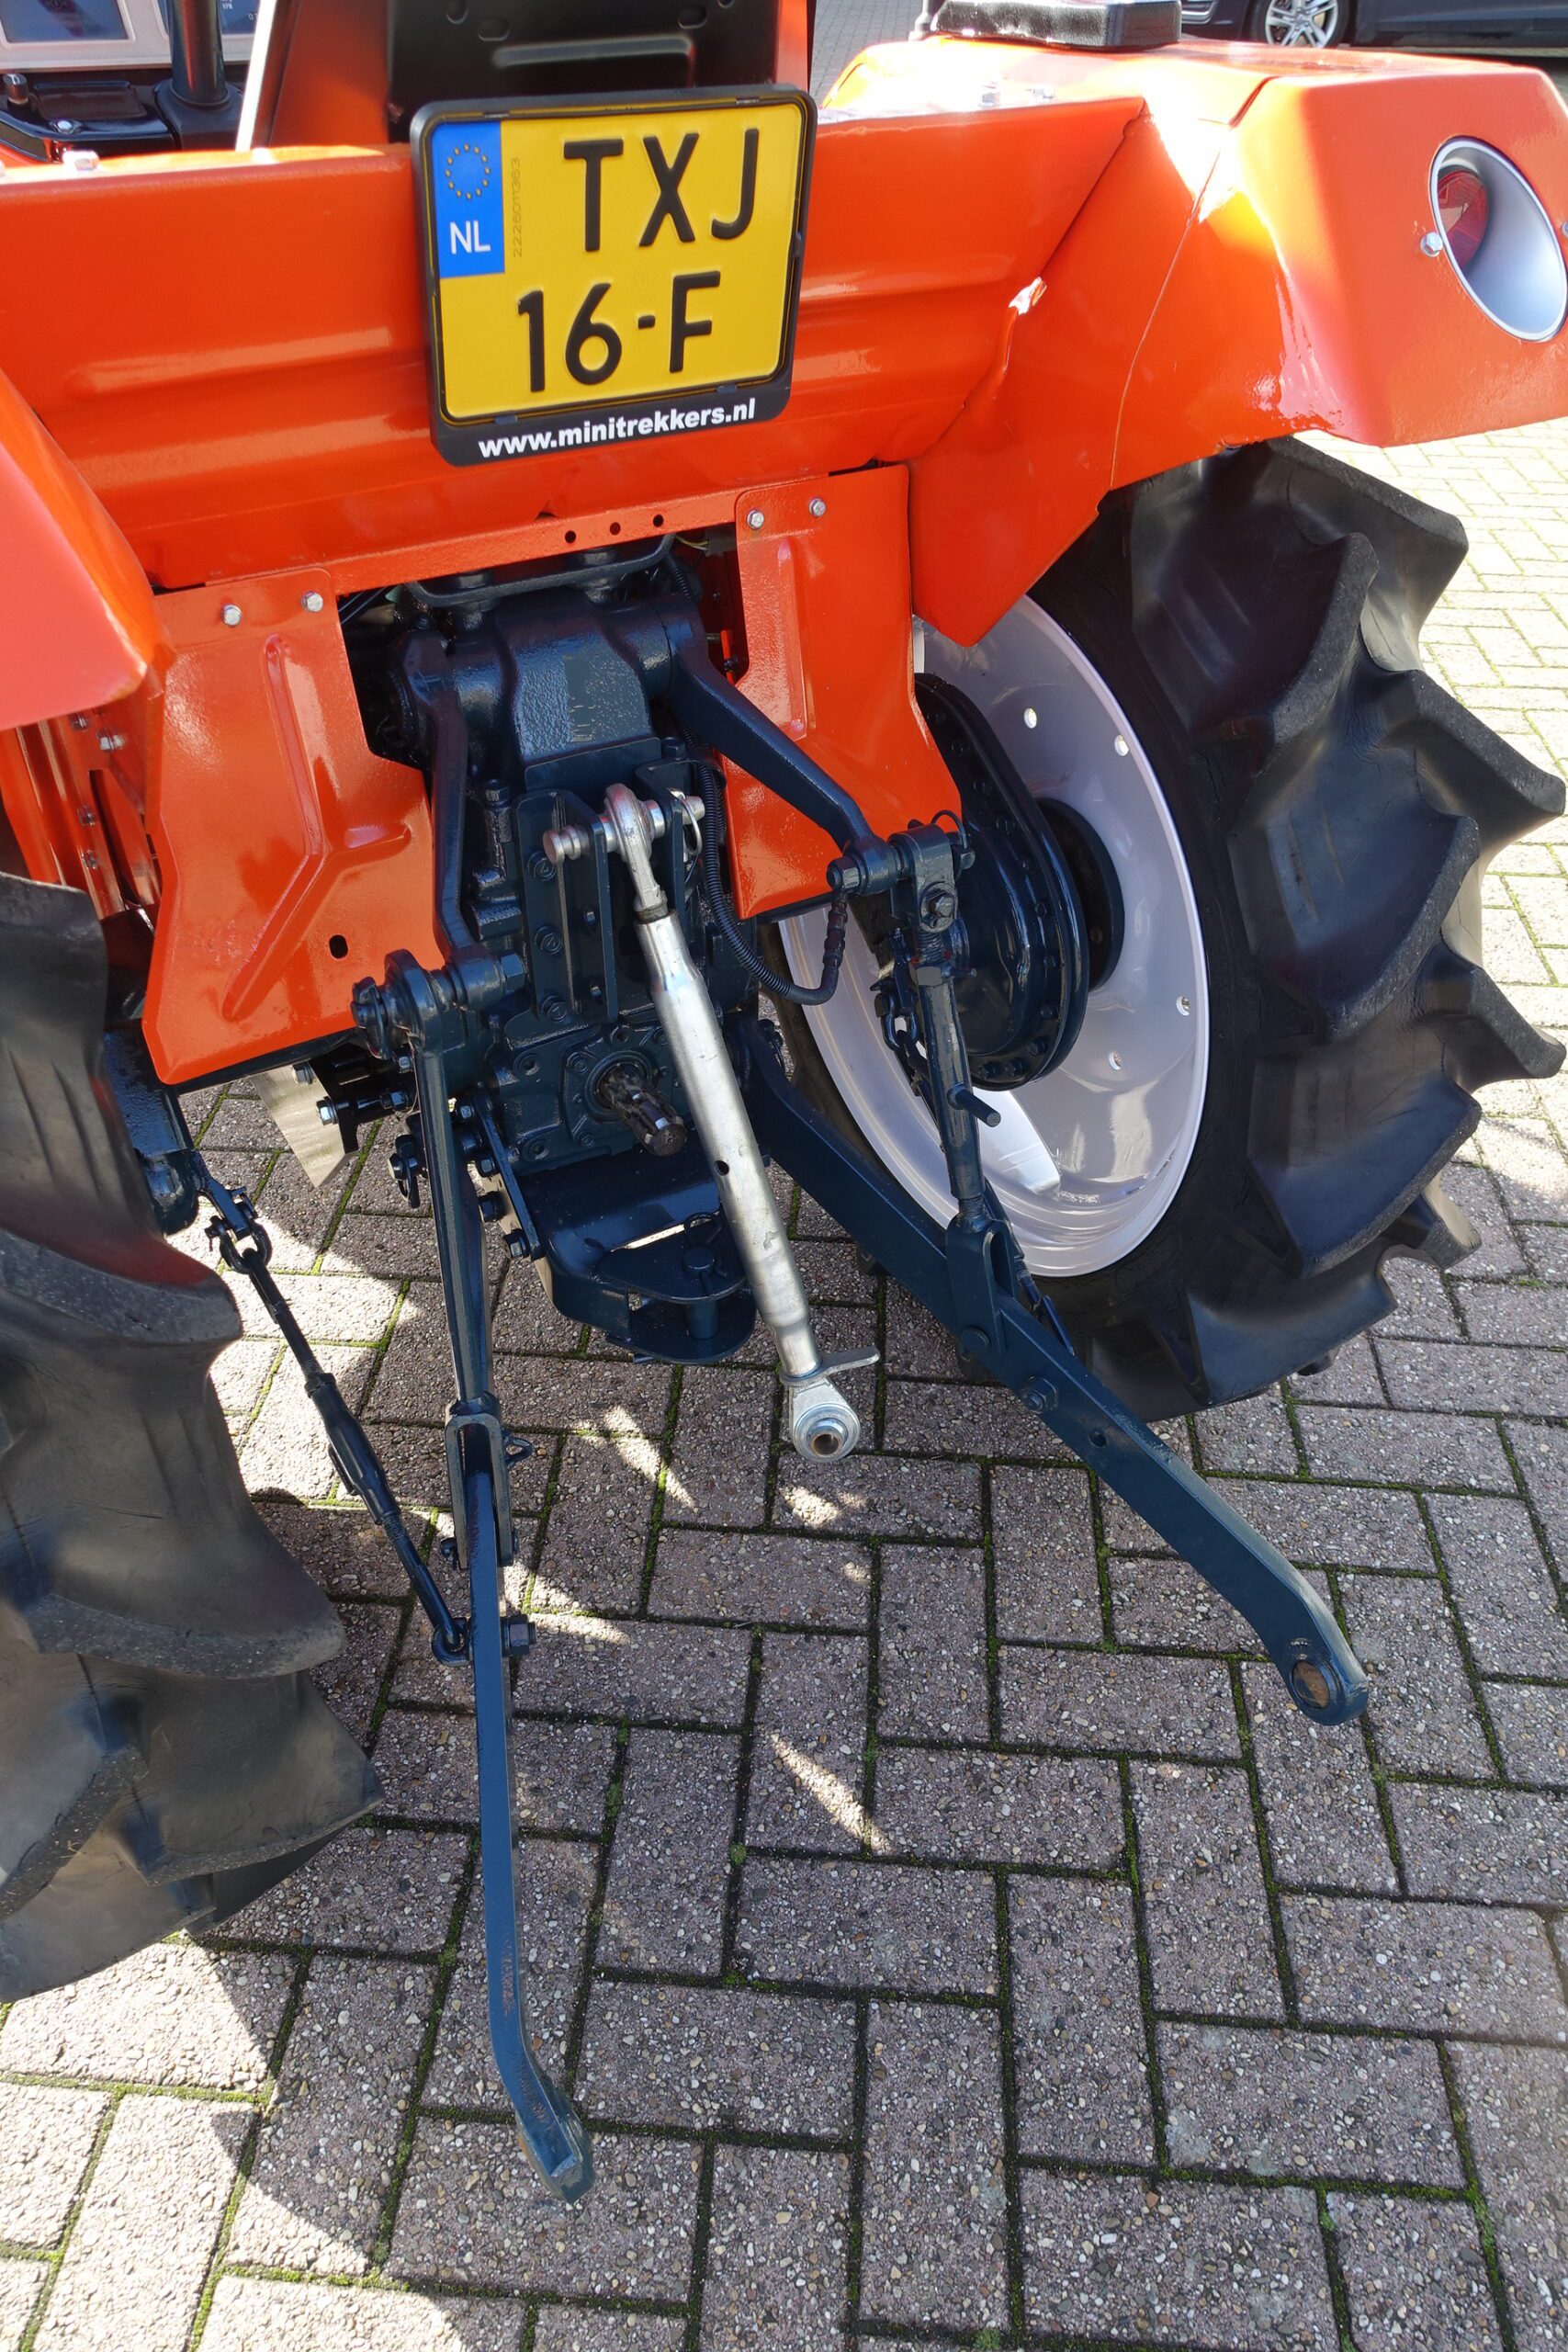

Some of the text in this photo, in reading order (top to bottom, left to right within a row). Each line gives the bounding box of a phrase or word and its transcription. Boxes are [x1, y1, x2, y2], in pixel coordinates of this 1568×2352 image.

[564, 128, 760, 252] TXJ
[449, 220, 491, 254] NL
[517, 270, 721, 392] 16-F
[479, 398, 756, 458] www.minitrekkers.nl
